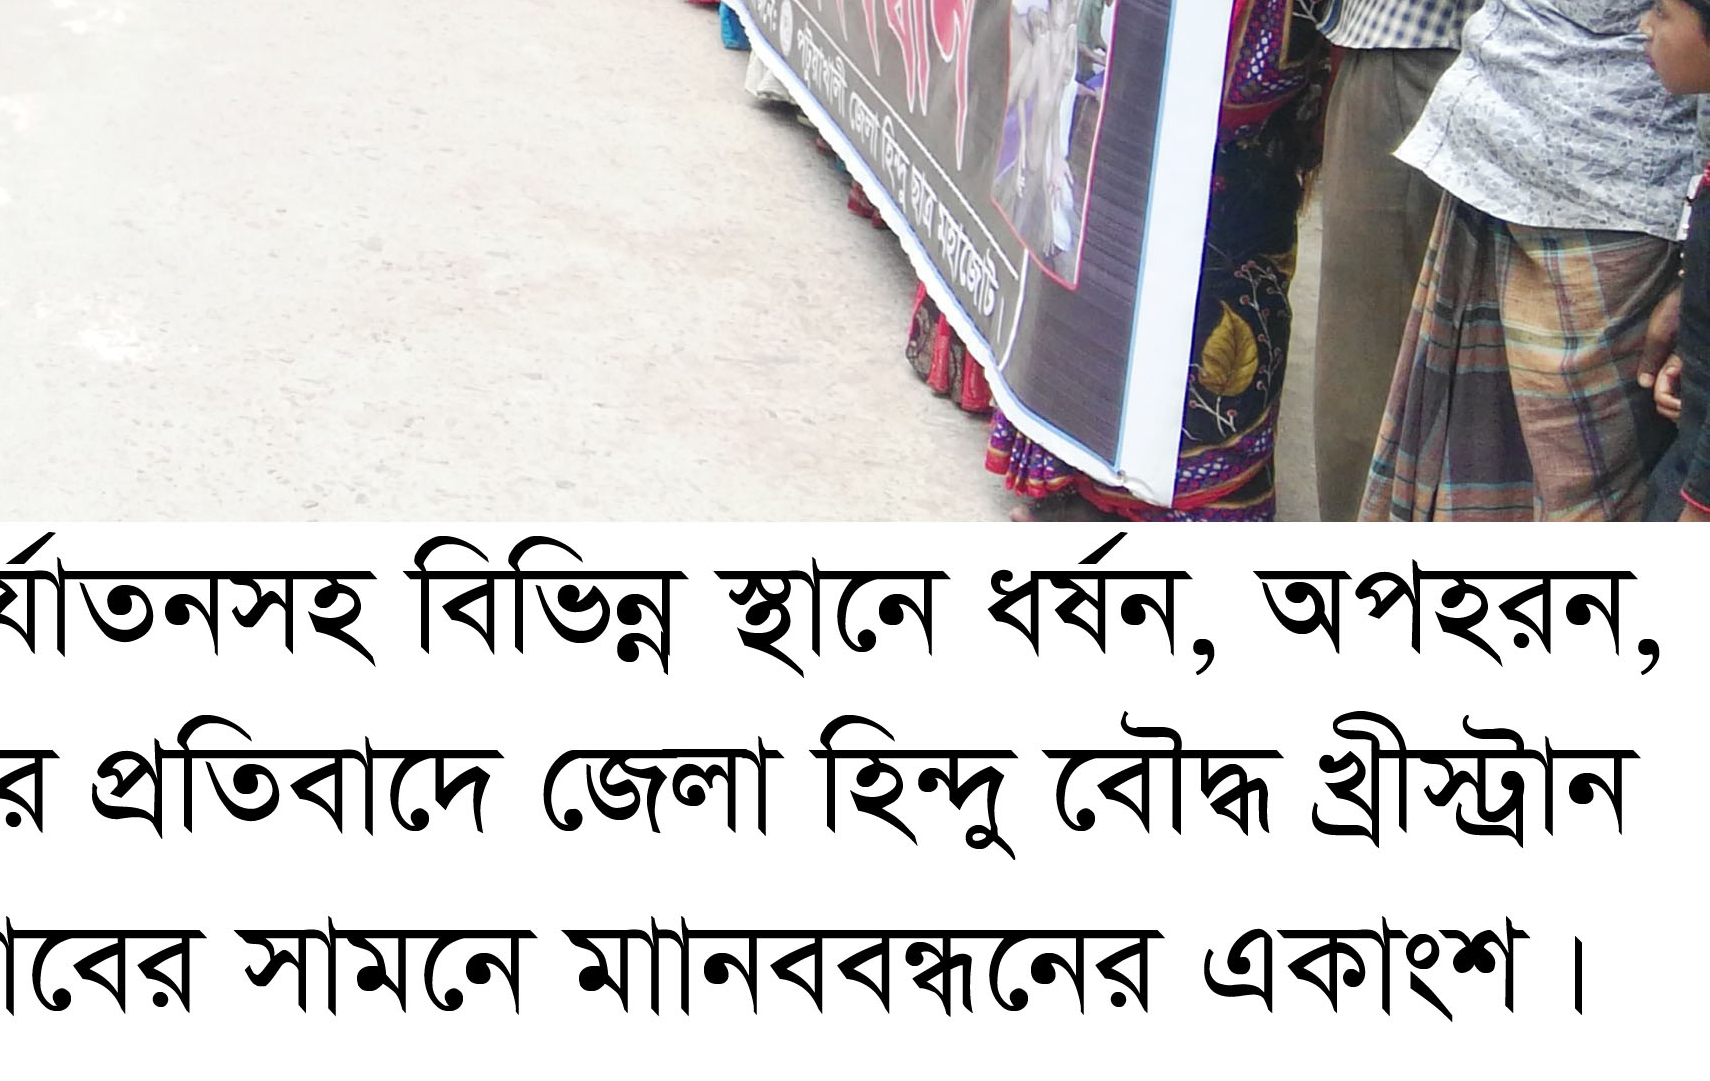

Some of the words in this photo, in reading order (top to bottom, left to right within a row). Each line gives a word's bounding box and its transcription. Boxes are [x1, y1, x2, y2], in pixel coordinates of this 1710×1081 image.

[796, 19, 849, 119] পটুয়াখালী
[849, 91, 882, 162] জেলা
[880, 115, 912, 211] হিন্দু
[936, 211, 1000, 319] মহাজোট
